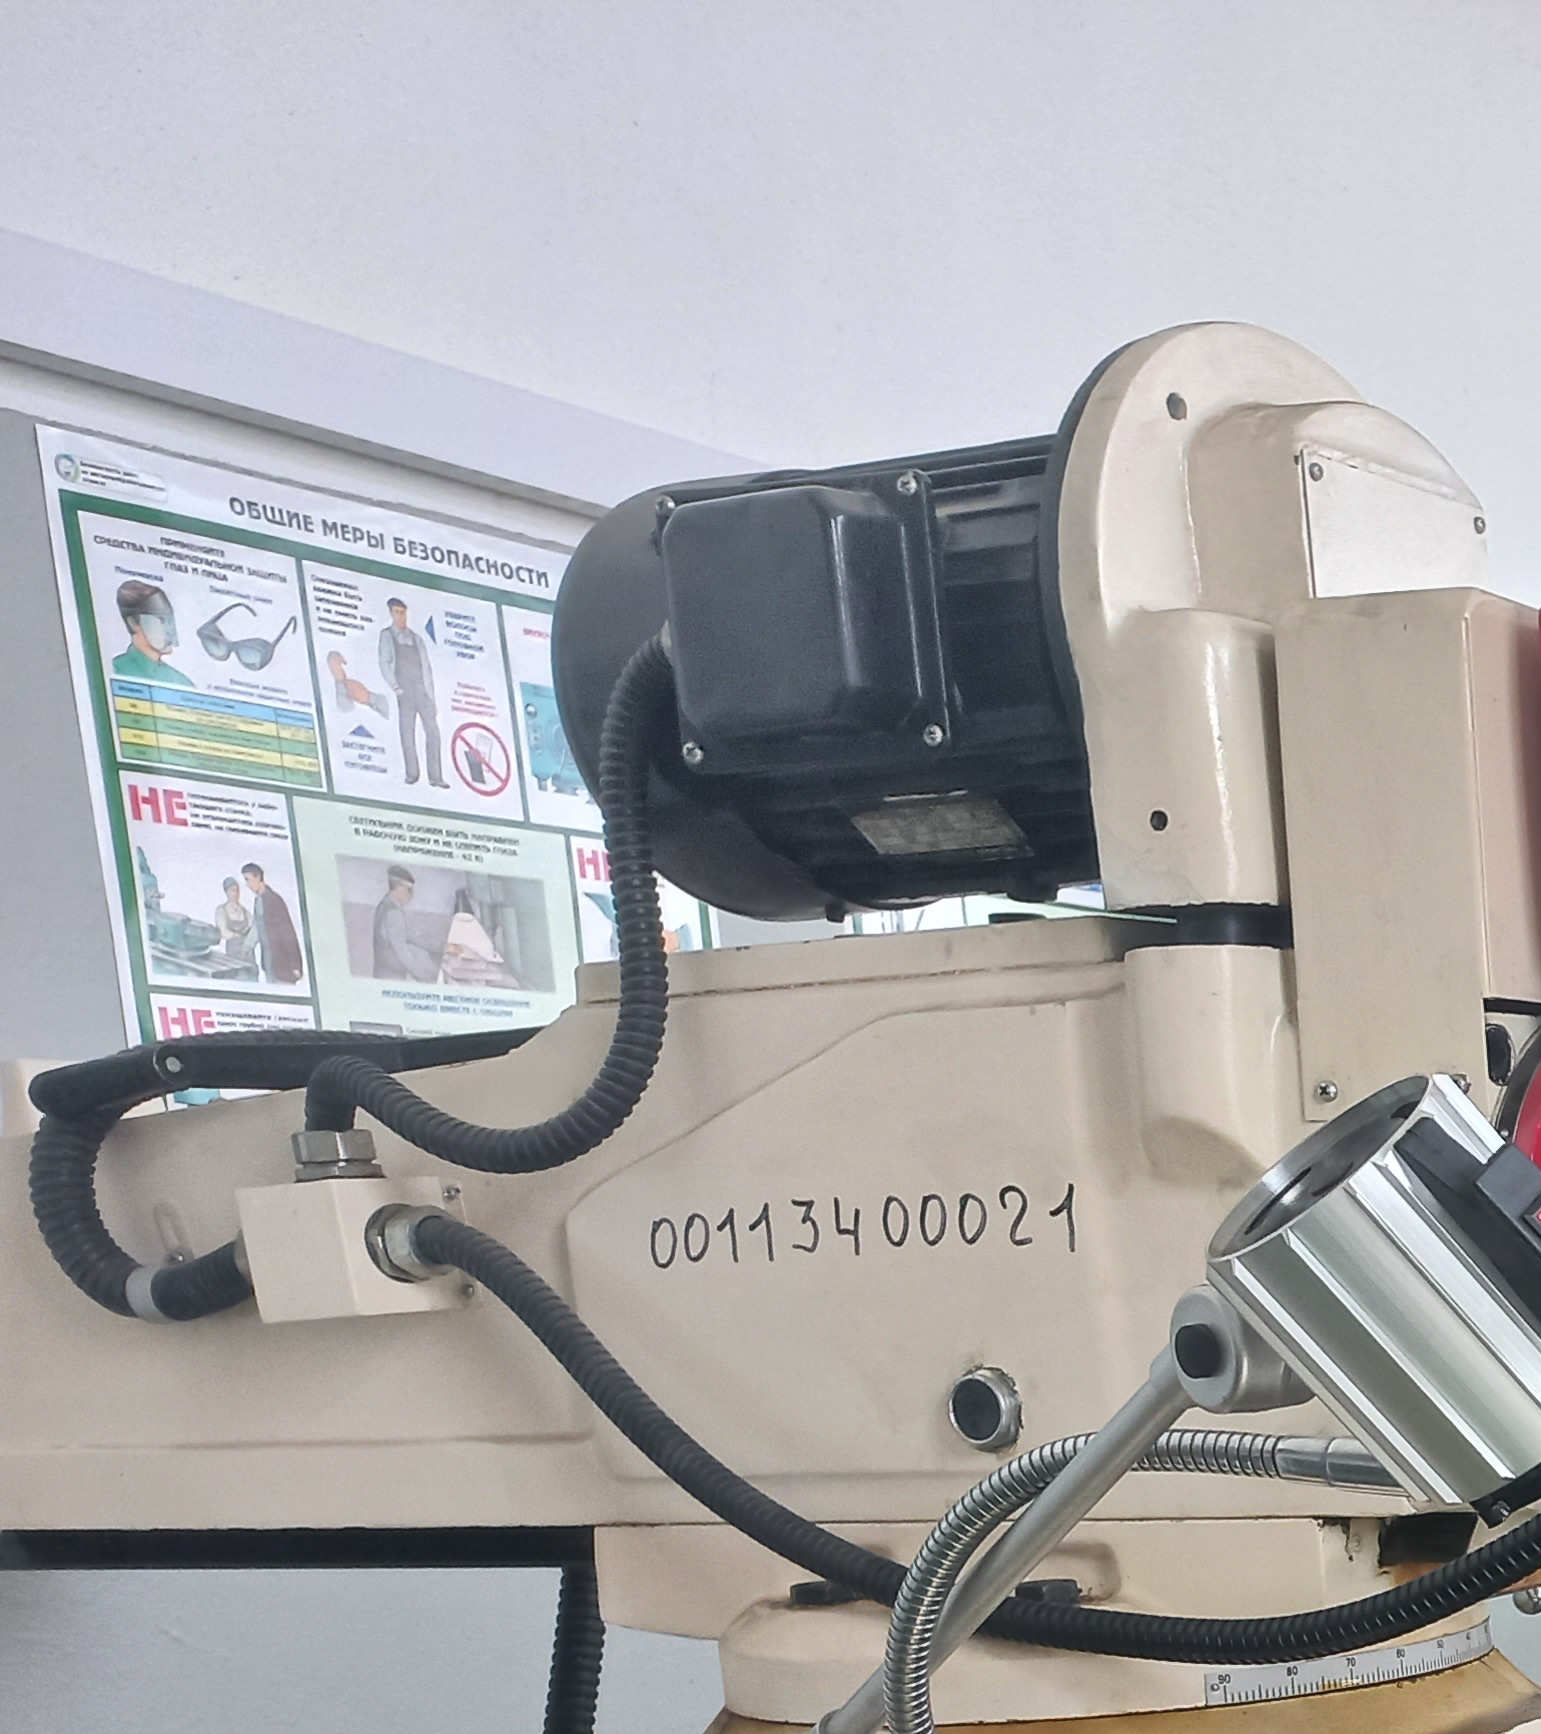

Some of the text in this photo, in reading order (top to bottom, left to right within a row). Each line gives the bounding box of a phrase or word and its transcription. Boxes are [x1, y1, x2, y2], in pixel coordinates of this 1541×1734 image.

[228, 496, 550, 589] ОБЩИЕ МЕРЫ БЕЗОПАСНОСТИ
[128, 784, 188, 827] НЕ
[650, 1182, 1077, 1270] 00113400021
[1217, 1673, 1231, 1685] 90
[1286, 1665, 1299, 1677] 80
[1345, 1657, 1356, 1668] 70
